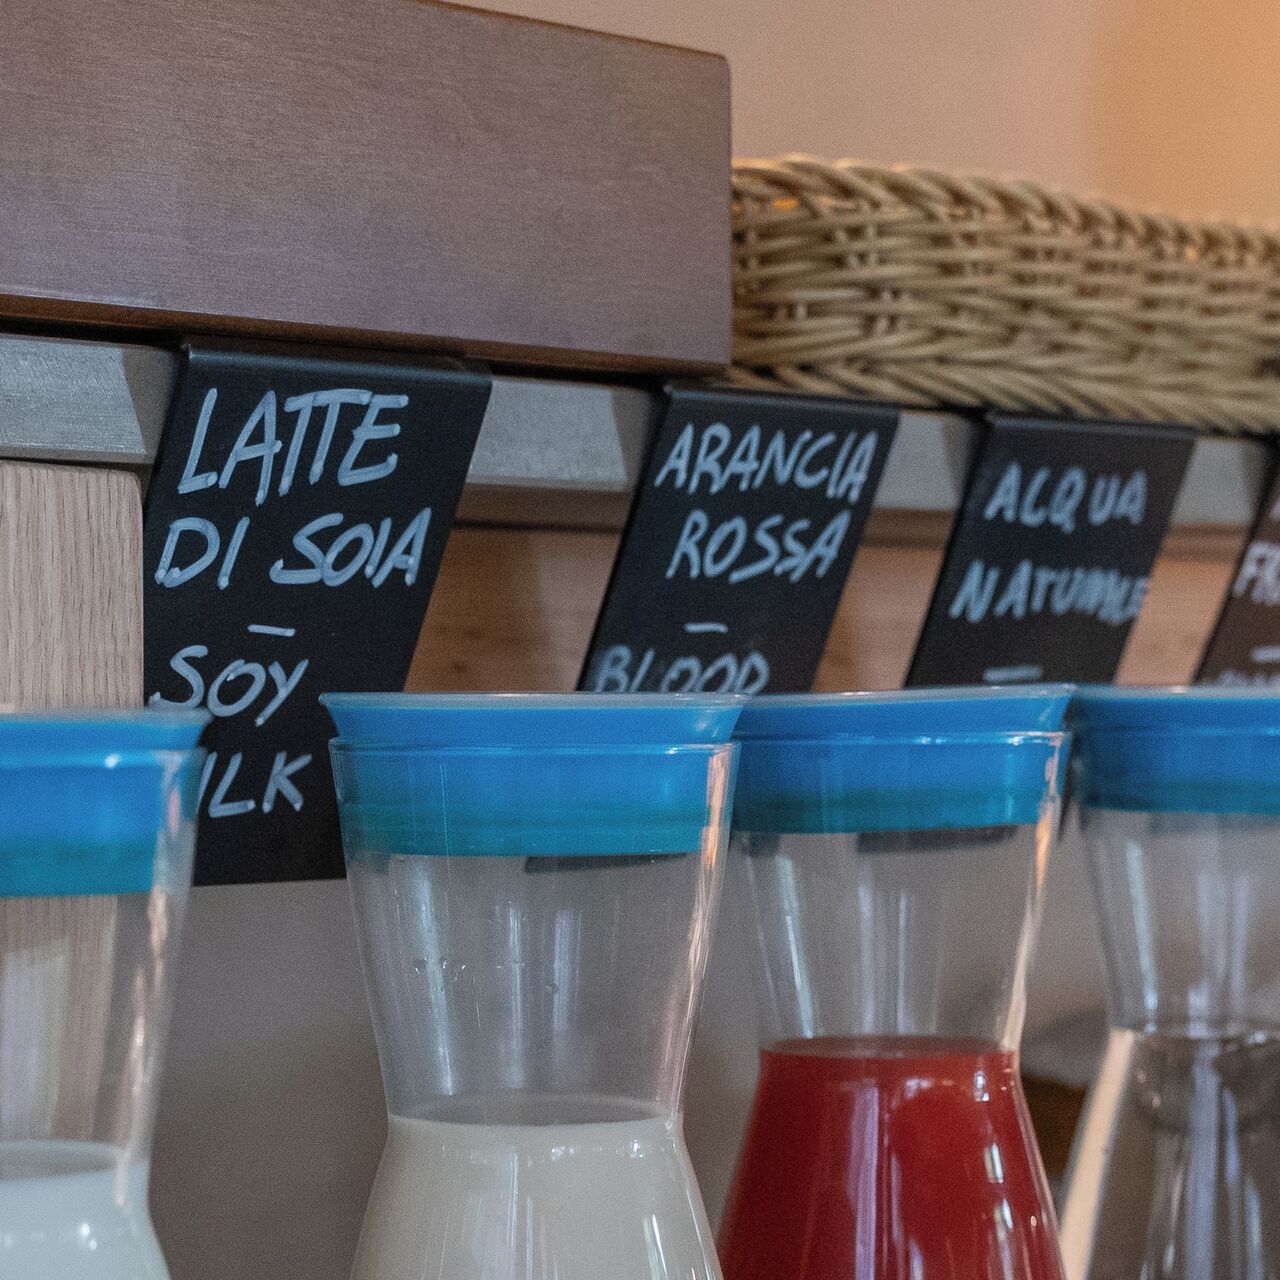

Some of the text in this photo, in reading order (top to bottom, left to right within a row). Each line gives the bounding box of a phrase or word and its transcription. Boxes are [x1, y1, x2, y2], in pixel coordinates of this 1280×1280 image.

[178, 388, 408, 506] LATTE
[654, 422, 878, 504] ARANCIA
[983, 463, 1147, 533] ACQUA
[156, 507, 432, 589] DI SOIA
[665, 510, 851, 584] ROSSA
[150, 645, 308, 726] SOY
[196, 751, 313, 818] ILK
